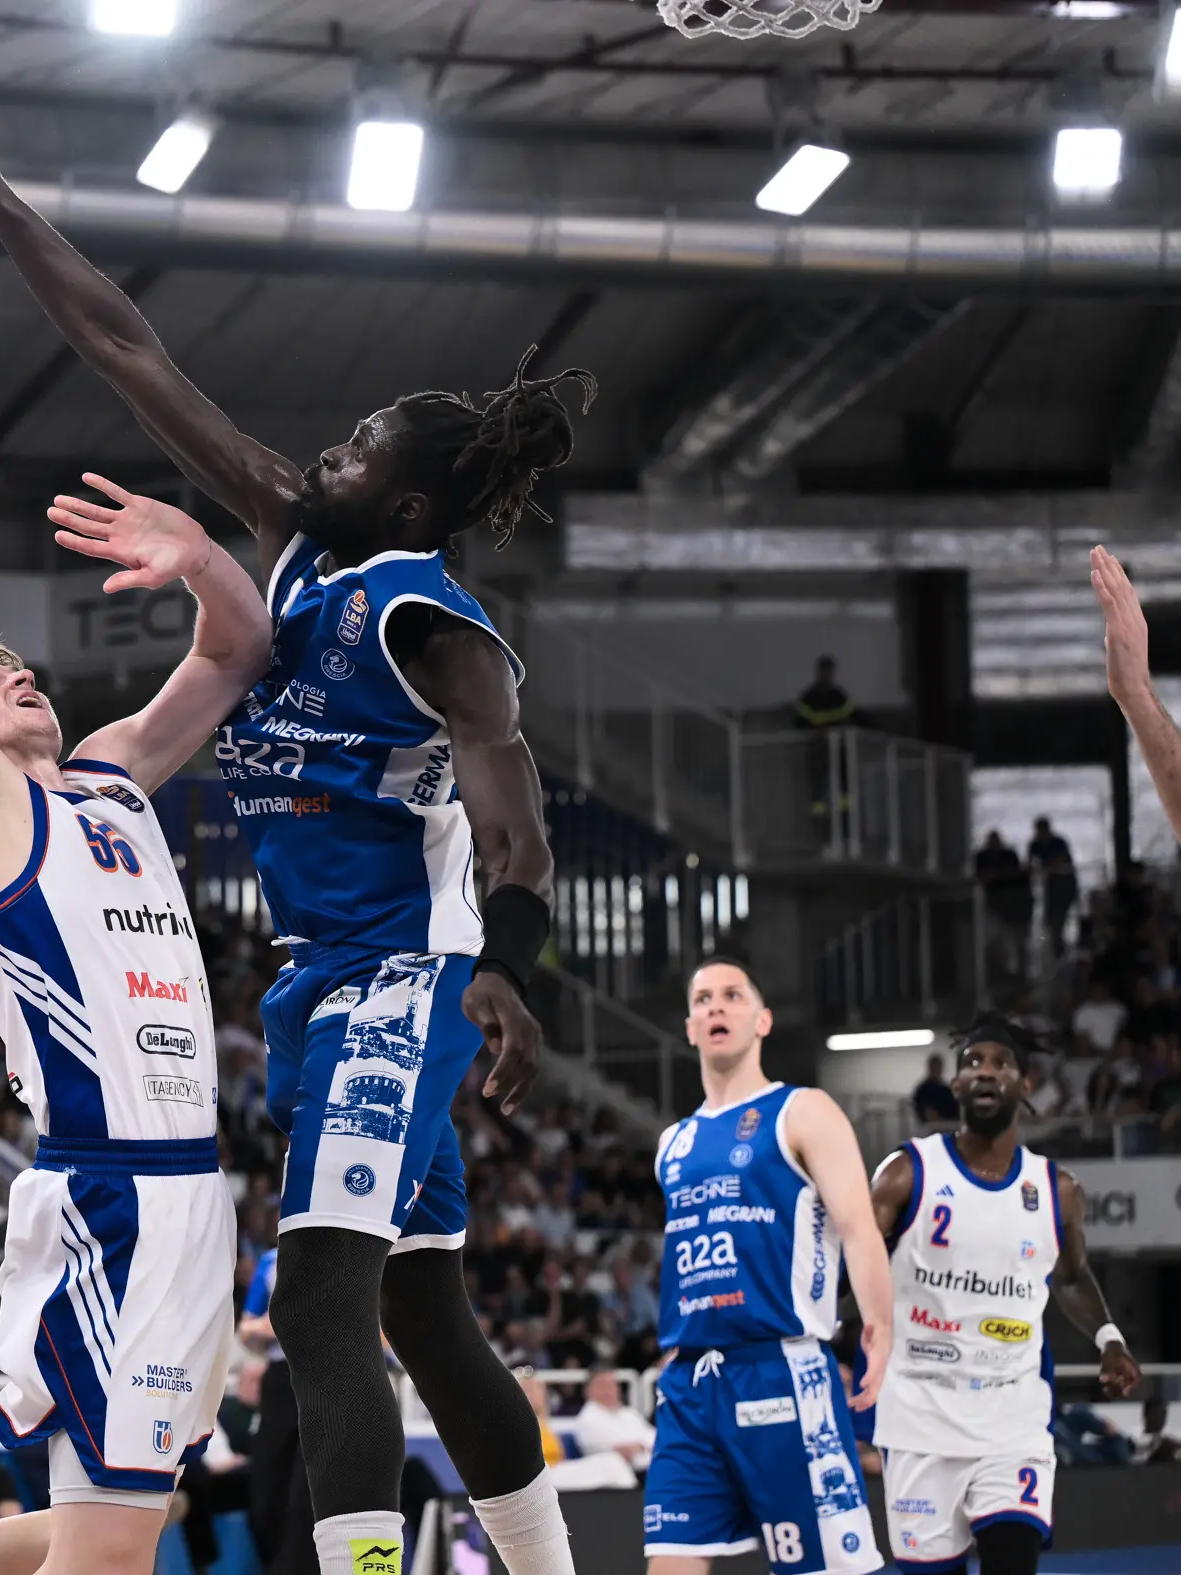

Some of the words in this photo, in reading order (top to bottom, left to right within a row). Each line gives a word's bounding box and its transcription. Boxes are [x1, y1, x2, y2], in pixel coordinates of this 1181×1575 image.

[345, 610, 362, 626] LBA
[669, 1178, 741, 1210] TECHNE
[930, 1203, 952, 1250] 2
[676, 1231, 739, 1275] a2a
[914, 1266, 1033, 1299] nutribullet
[985, 1321, 1030, 1338] CRICH
[146, 1377, 193, 1393] BUILDERS
[1018, 1465, 1039, 1507] 2
[761, 1521, 805, 1564] 18
[362, 1562, 396, 1574] PRS
